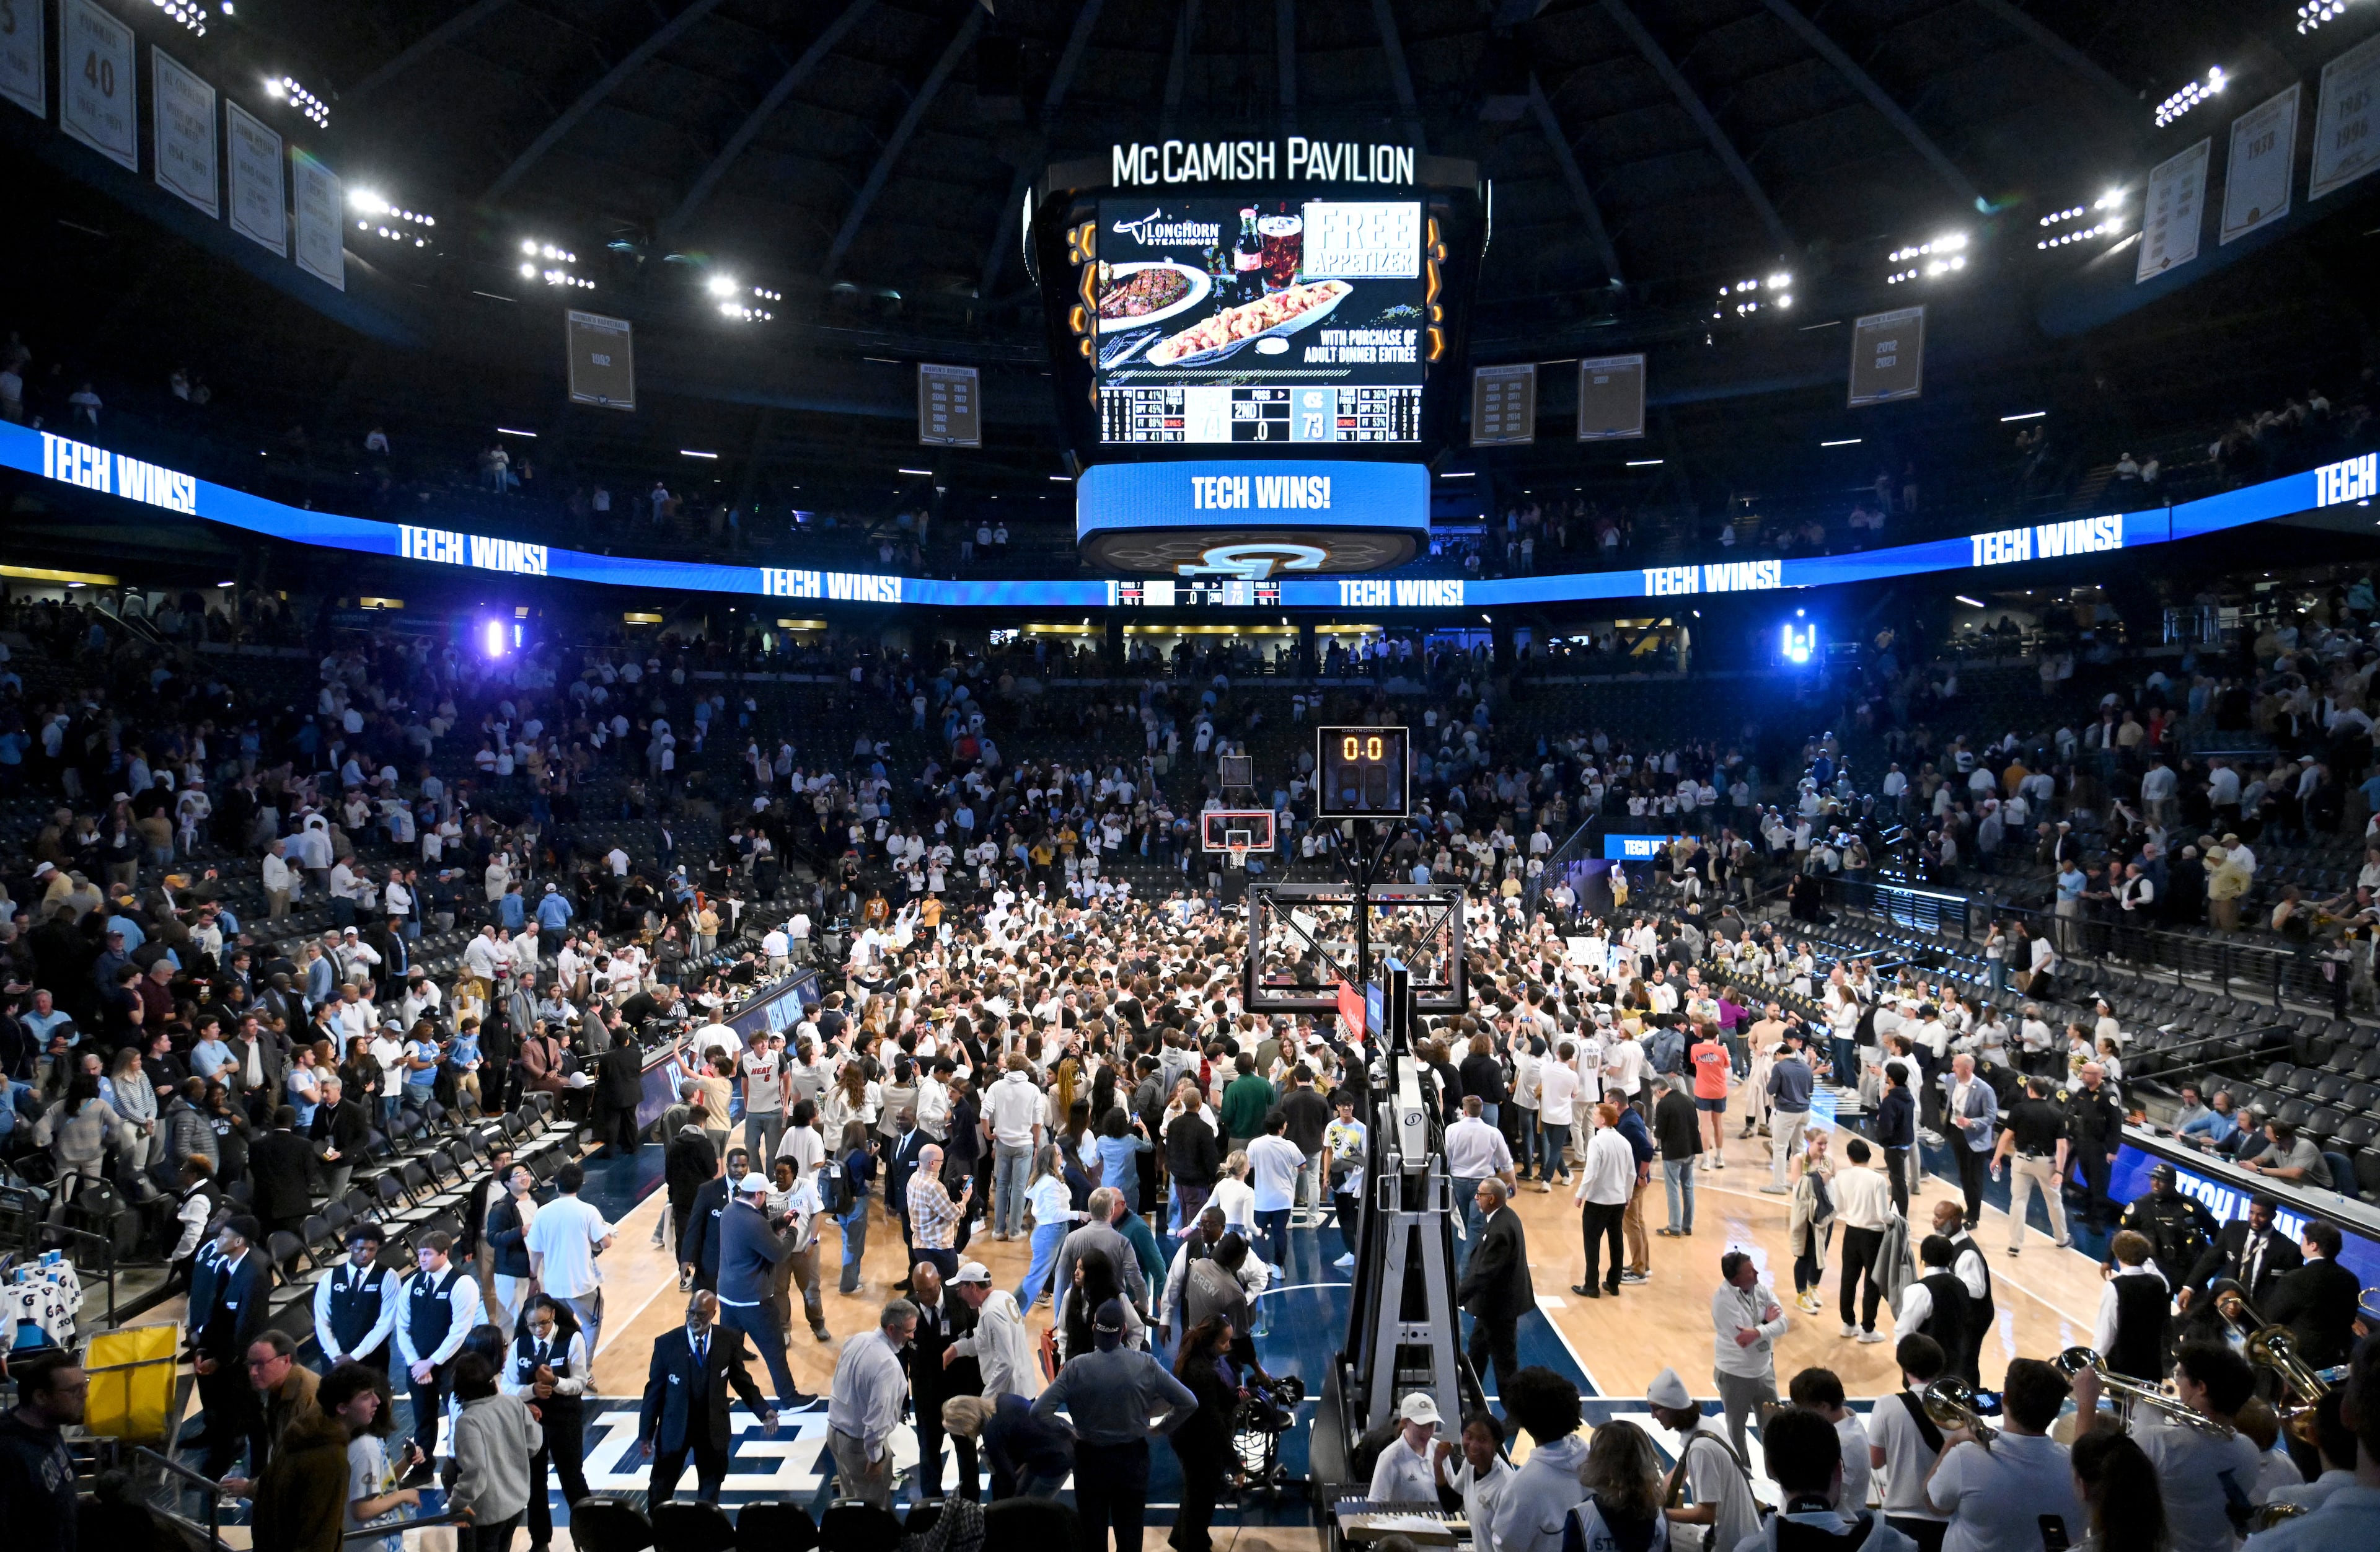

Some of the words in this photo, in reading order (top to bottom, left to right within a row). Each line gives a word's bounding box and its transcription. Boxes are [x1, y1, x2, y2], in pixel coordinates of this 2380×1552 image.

[84, 50, 114, 97] 40
[1316, 208, 1412, 249] FREE
[1315, 252, 1412, 273] APPETIZER
[1320, 330, 1347, 346] WITH
[1349, 330, 1402, 346] PURCHASE
[1404, 330, 1417, 346] OF
[1303, 346, 1337, 363] ADULT
[1338, 346, 1377, 363] DINNER
[1148, 390, 1161, 400] 41%
[1252, 390, 1271, 400] POSS
[1373, 390, 1386, 399] 36%
[1148, 404, 1161, 413] 45%
[1171, 405, 1177, 415] 7
[1235, 403, 1257, 418] 2ND
[1343, 404, 1352, 415] 10
[1373, 404, 1385, 413] 29%
[1302, 413, 1324, 438] 73
[1373, 418, 1385, 427] 53%
[1150, 432, 1160, 441] 41
[1177, 432, 1182, 441] 0
[1253, 421, 1268, 441] .0
[1351, 431, 1355, 441] 1
[1373, 431, 1383, 440] 48
[40, 431, 110, 493] TECH
[117, 454, 196, 503] WINS!
[2314, 452, 2376, 508] TECH
[1191, 476, 1249, 509] TECH
[1255, 476, 1331, 509] WINS!
[1970, 527, 2030, 567] TECH
[2036, 514, 2122, 558] WINS!
[398, 524, 464, 565] TECH
[470, 535, 547, 576] WINS!
[760, 567, 820, 597] TECH
[827, 572, 902, 602] WINS!
[1642, 565, 1699, 596] TECH
[1704, 560, 1781, 592] WINS!
[1186, 591, 1197, 605] .0
[1210, 592, 1222, 603] 2ND
[1230, 591, 1244, 605] 73
[1338, 580, 1391, 606] TECH
[1396, 580, 1464, 606] WINS!
[1344, 737, 1382, 761] 0.0
[1624, 840, 1650, 855] TECH
[765, 1003, 785, 1033] TECH
[751, 1065, 772, 1075] HEAT
[764, 1074, 770, 1082] 6
[790, 1199, 803, 1207] TECH
[1192, 1271, 1220, 1297] CREW
